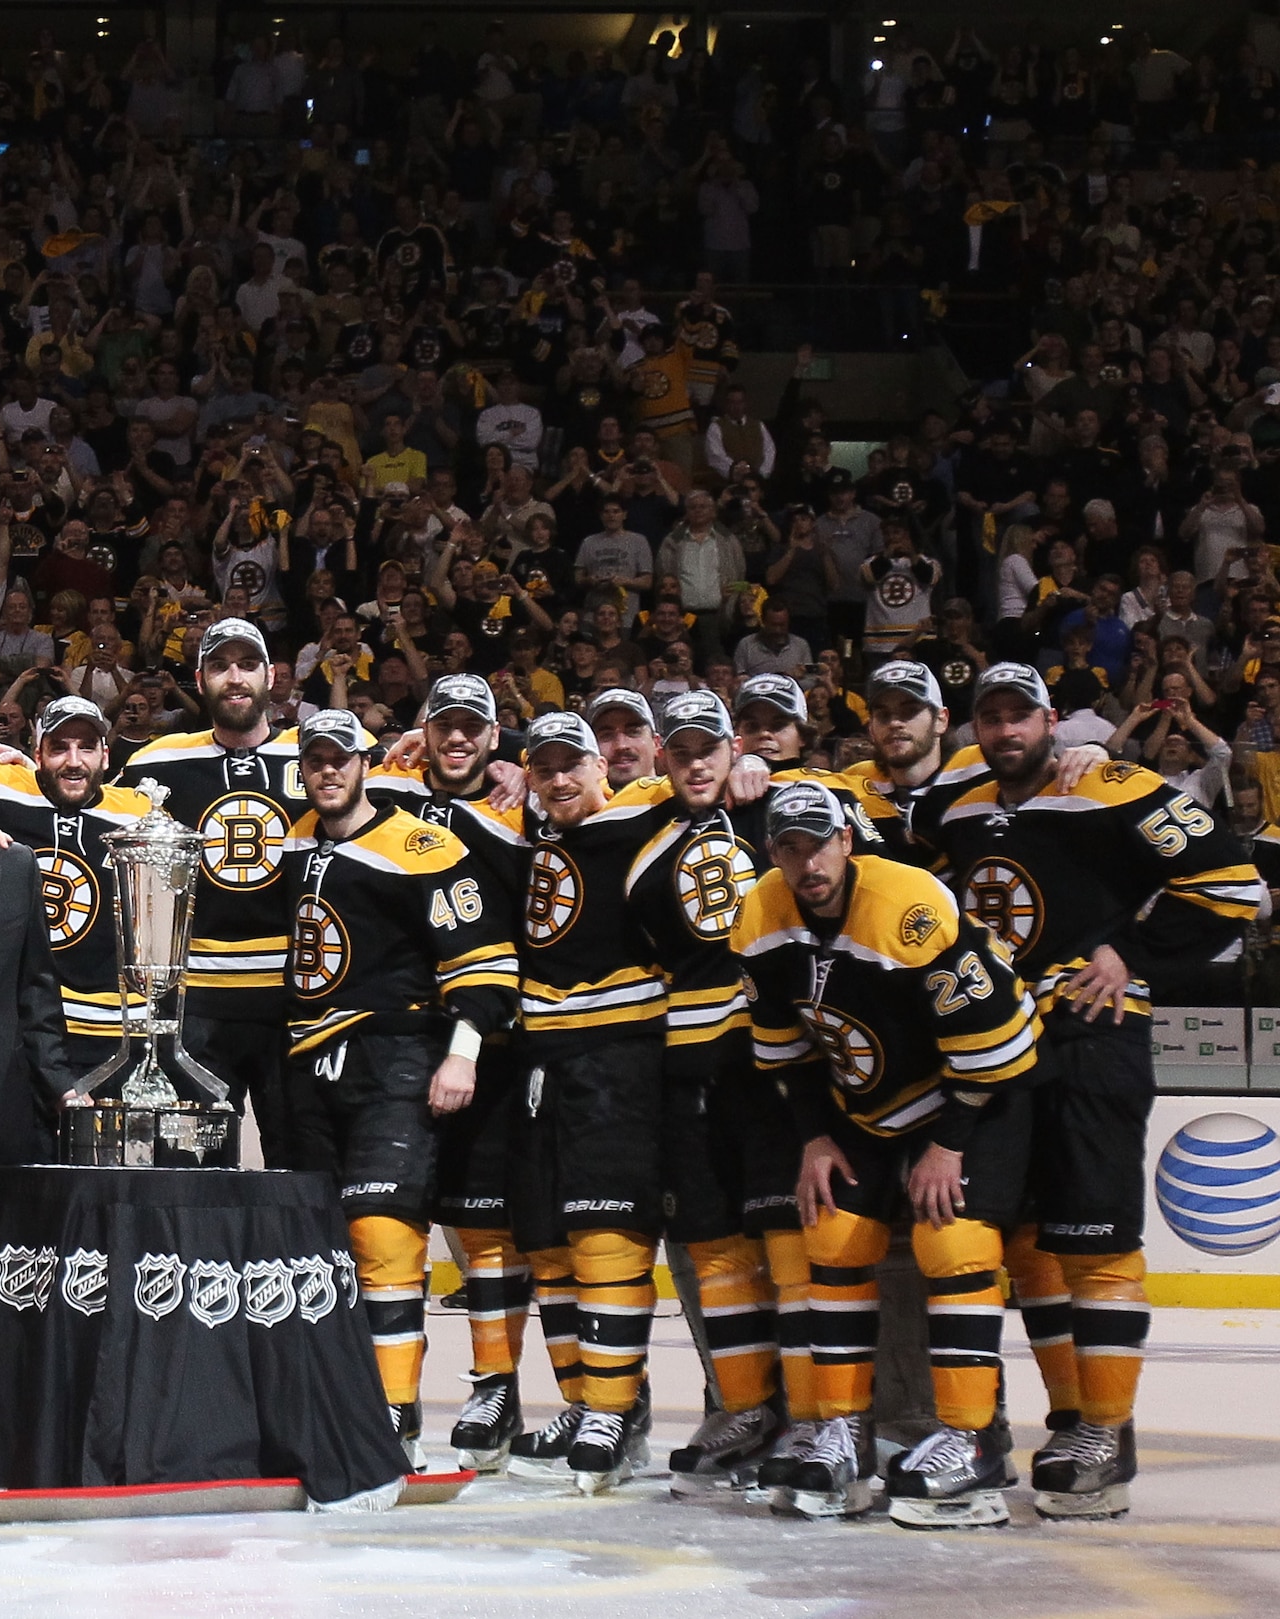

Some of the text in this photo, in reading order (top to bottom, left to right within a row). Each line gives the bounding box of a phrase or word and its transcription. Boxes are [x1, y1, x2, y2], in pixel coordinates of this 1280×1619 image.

[222, 815, 266, 868] B
[1138, 793, 1214, 857] 55
[40, 870, 75, 928] B
[429, 878, 483, 931] 46
[528, 864, 559, 925] B
[691, 855, 740, 920] B
[295, 918, 323, 976] B
[904, 907, 933, 939] BRUINS
[926, 951, 994, 1016] 23
[563, 1198, 635, 1213] BAUER
[77, 1271, 107, 1297] NHL
[148, 1273, 174, 1301] NHL
[199, 1280, 226, 1308] NHL
[253, 1279, 281, 1308] NHL
[299, 1277, 322, 1305] NHL
